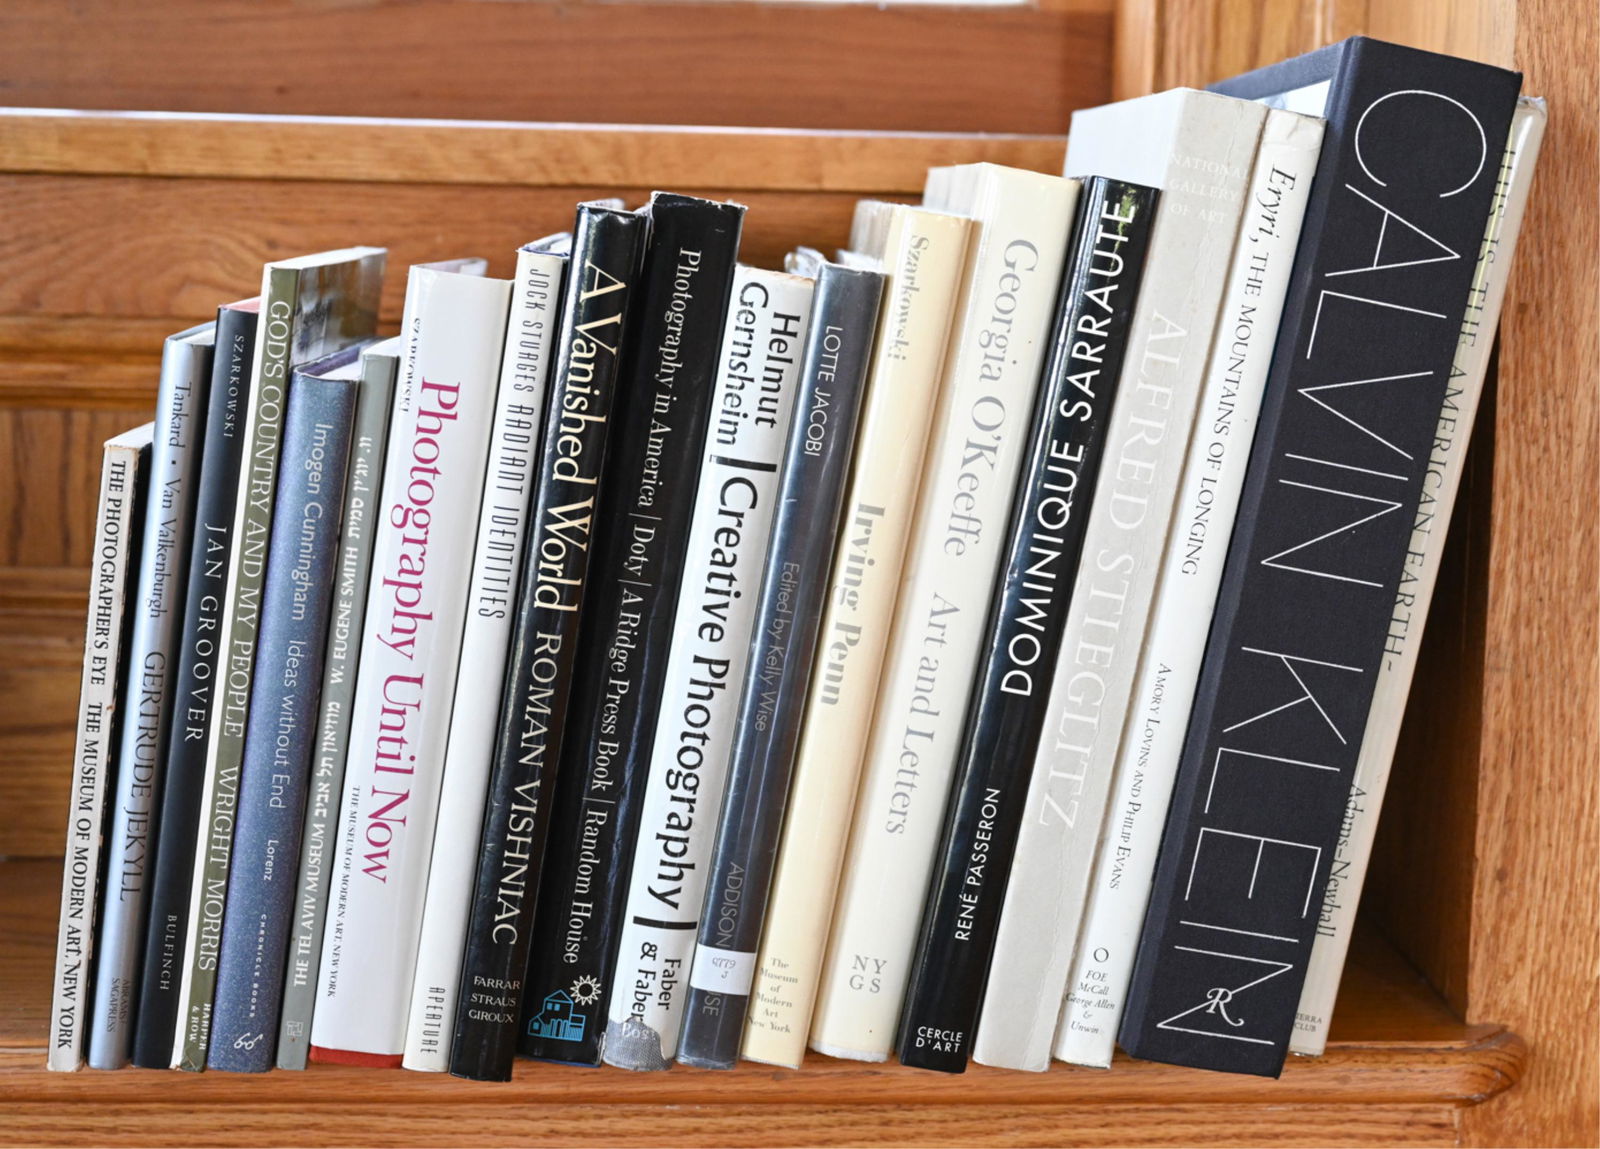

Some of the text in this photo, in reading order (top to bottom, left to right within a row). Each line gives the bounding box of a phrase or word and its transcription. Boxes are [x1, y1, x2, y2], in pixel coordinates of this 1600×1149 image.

[1169, 179, 1238, 201] GALLERY
[1170, 203, 1226, 223] OF ART
[1244, 252, 1269, 296] THE
[1478, 238, 1498, 263] IS
[1460, 283, 1488, 346] THE
[716, 282, 769, 446] Gernsheim
[755, 312, 801, 429] Helmut
[1213, 304, 1257, 437] MOUNTAINS
[820, 234, 930, 706] Szarkowski Irving Penn
[1206, 441, 1225, 471] OF
[1411, 364, 1467, 534] AMERICAN
[348, 497, 364, 538] סמית
[377, 377, 461, 660] Photography
[885, 239, 1039, 835] Georgia O'Keeffe Art and Letters
[1182, 477, 1217, 576] LONGING
[955, 200, 1135, 941] RENÉ PASSERON DOMINIQUE SARRAUTE
[1040, 310, 1188, 829] ALFRED STIEGLITZ
[1157, 89, 1487, 1045] CALVIN KLEIN
[331, 547, 358, 684] W. EUGENE SMITH
[492, 259, 627, 945] A Vanished World ROMAN VISHNIAC
[562, 247, 702, 964] Photography in America Doty A Ridge Press Book Random House
[119, 382, 192, 902] Tankard Van Valkenburgh GERTRUDE JEKYLL
[198, 301, 291, 971] GOD'S COUNTRY AND MY PEOPLE WRIGHT MORRIS
[420, 268, 550, 1054] JOCK STURGES RADIANT IDENTITIES APERTURE
[716, 326, 843, 947] LOTTE JACOBI Edited by Kelly Wise ADDISON
[160, 335, 245, 990] SZARKOWSKI JAN GROOVER BULFINCH
[647, 476, 758, 910] Creative Photography
[249, 423, 333, 1018] Imogen Cunningham Ideas without End Lorenz CHRONICLE BOOKS
[374, 673, 424, 775] Until
[58, 461, 126, 1049] THE PHOTOGRAPHER'S EYE THE MUSEUM OF MODERN ART, NEW YORK
[314, 701, 340, 818] מוזיאון תל אביב
[351, 786, 360, 808] THE
[346, 811, 357, 855] MUSEUM
[361, 785, 410, 883] Now
[344, 856, 352, 871] OF
[294, 823, 325, 987] THE TEL AVIV MUSEUM
[338, 873, 349, 917] MODERN
[332, 945, 341, 967] NEW
[640, 942, 657, 961] &
[760, 968, 798, 983] Museum
[771, 957, 789, 968] The
[1086, 970, 1108, 982] FOE
[107, 977, 120, 1032] SAGAPRESS
[327, 970, 338, 998] YORK
[470, 993, 516, 1007] STRAUS
[474, 976, 521, 990] FARRAR
[631, 969, 656, 1022] Faber
[658, 958, 681, 1011] Faber
[756, 992, 792, 1007] Modern
[770, 984, 781, 993] of
[1066, 992, 1115, 1010] George Allen
[1079, 982, 1109, 996] McCall
[189, 1006, 199, 1043] & ROW
[198, 1003, 211, 1051] HARPER
[468, 1009, 514, 1024] GIROUX
[764, 1008, 778, 1018] Art
[770, 1022, 791, 1033] York
[918, 1026, 963, 1042] CERCLE
[1071, 1020, 1099, 1034] Unwin
[915, 1037, 961, 1053] D'ART
